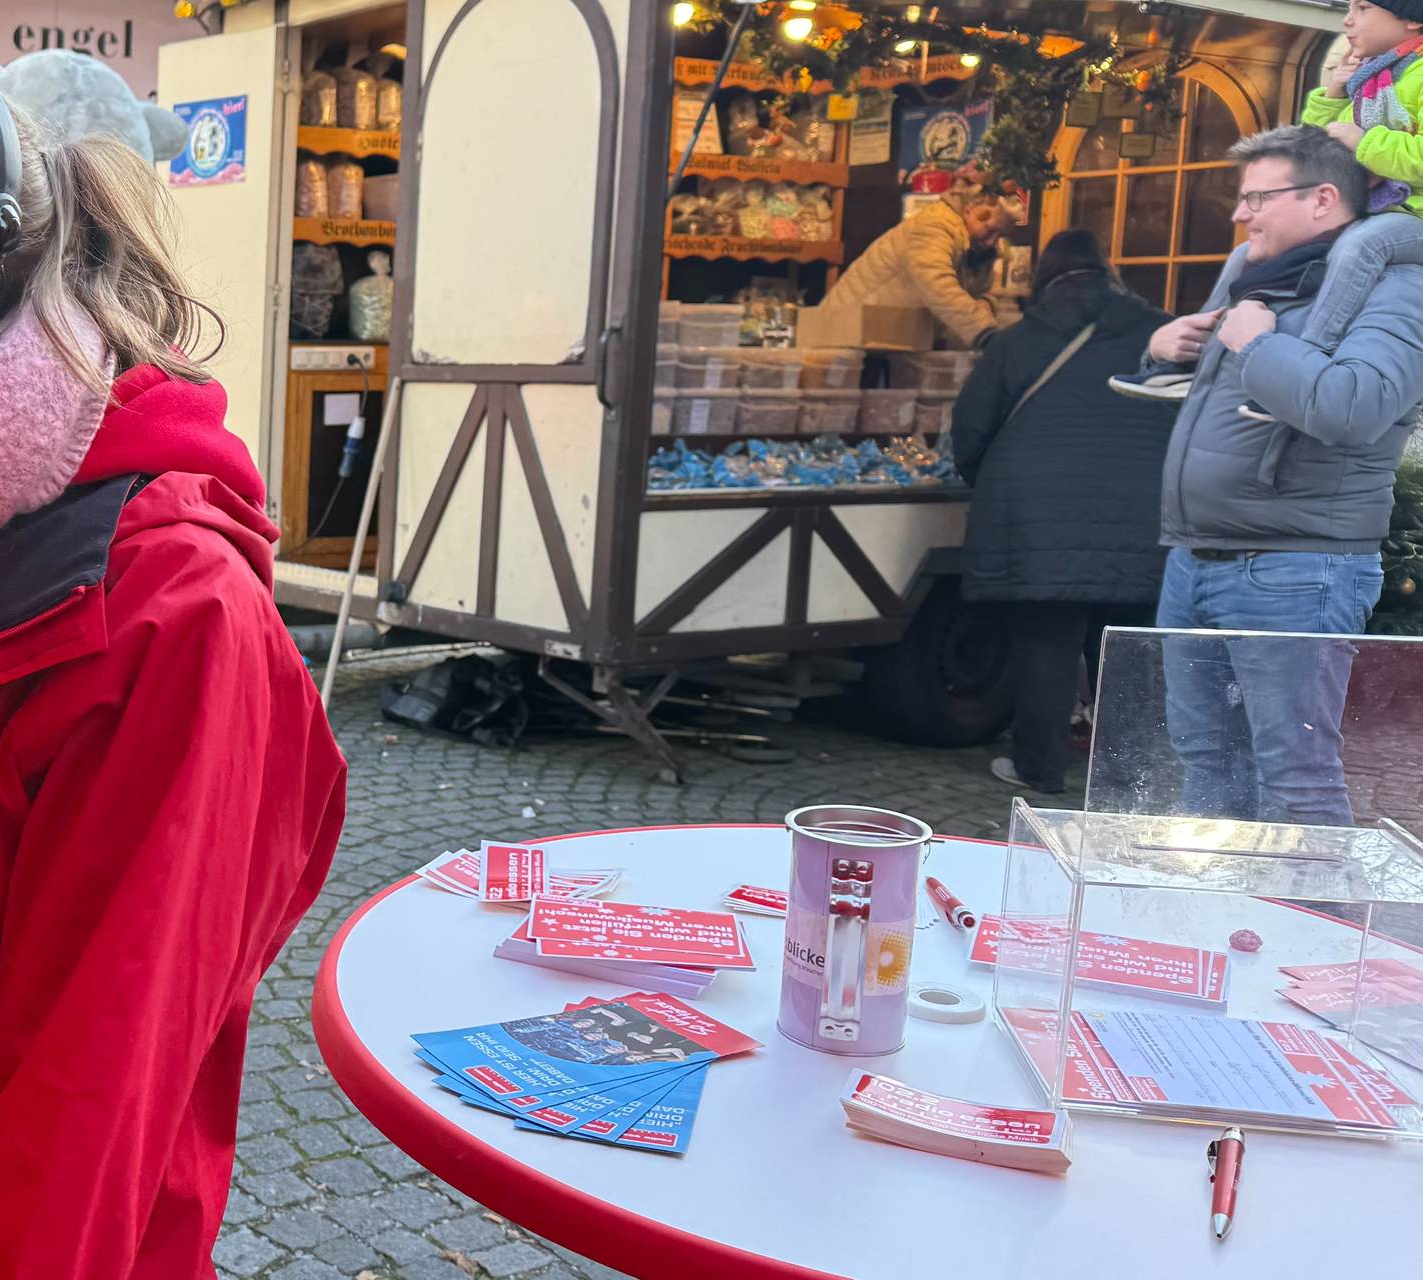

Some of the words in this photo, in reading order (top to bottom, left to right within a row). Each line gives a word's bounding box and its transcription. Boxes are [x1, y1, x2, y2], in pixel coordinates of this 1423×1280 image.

[13, 20, 133, 58] engel
[538, 908, 674, 927] Musikwunsch!
[579, 918, 654, 931] erfüllen
[562, 923, 606, 935] jetzt
[613, 928, 643, 939] Sie
[659, 926, 691, 935] wir
[681, 922, 733, 933] Ihren
[697, 930, 734, 939] und
[650, 931, 735, 947] Spenden
[785, 937, 825, 968] blicke
[1113, 957, 1148, 968] wir
[1137, 955, 1194, 968] Ihren
[1154, 963, 1194, 975] und
[1100, 963, 1194, 985] Spenden
[463, 1035, 500, 1059] ESSEN
[495, 1043, 522, 1061] SEID
[1075, 1059, 1111, 1100] Spenden
[872, 1078, 940, 1106] 102.2
[887, 1093, 954, 1117] radio
[959, 1114, 1041, 1130] essen
